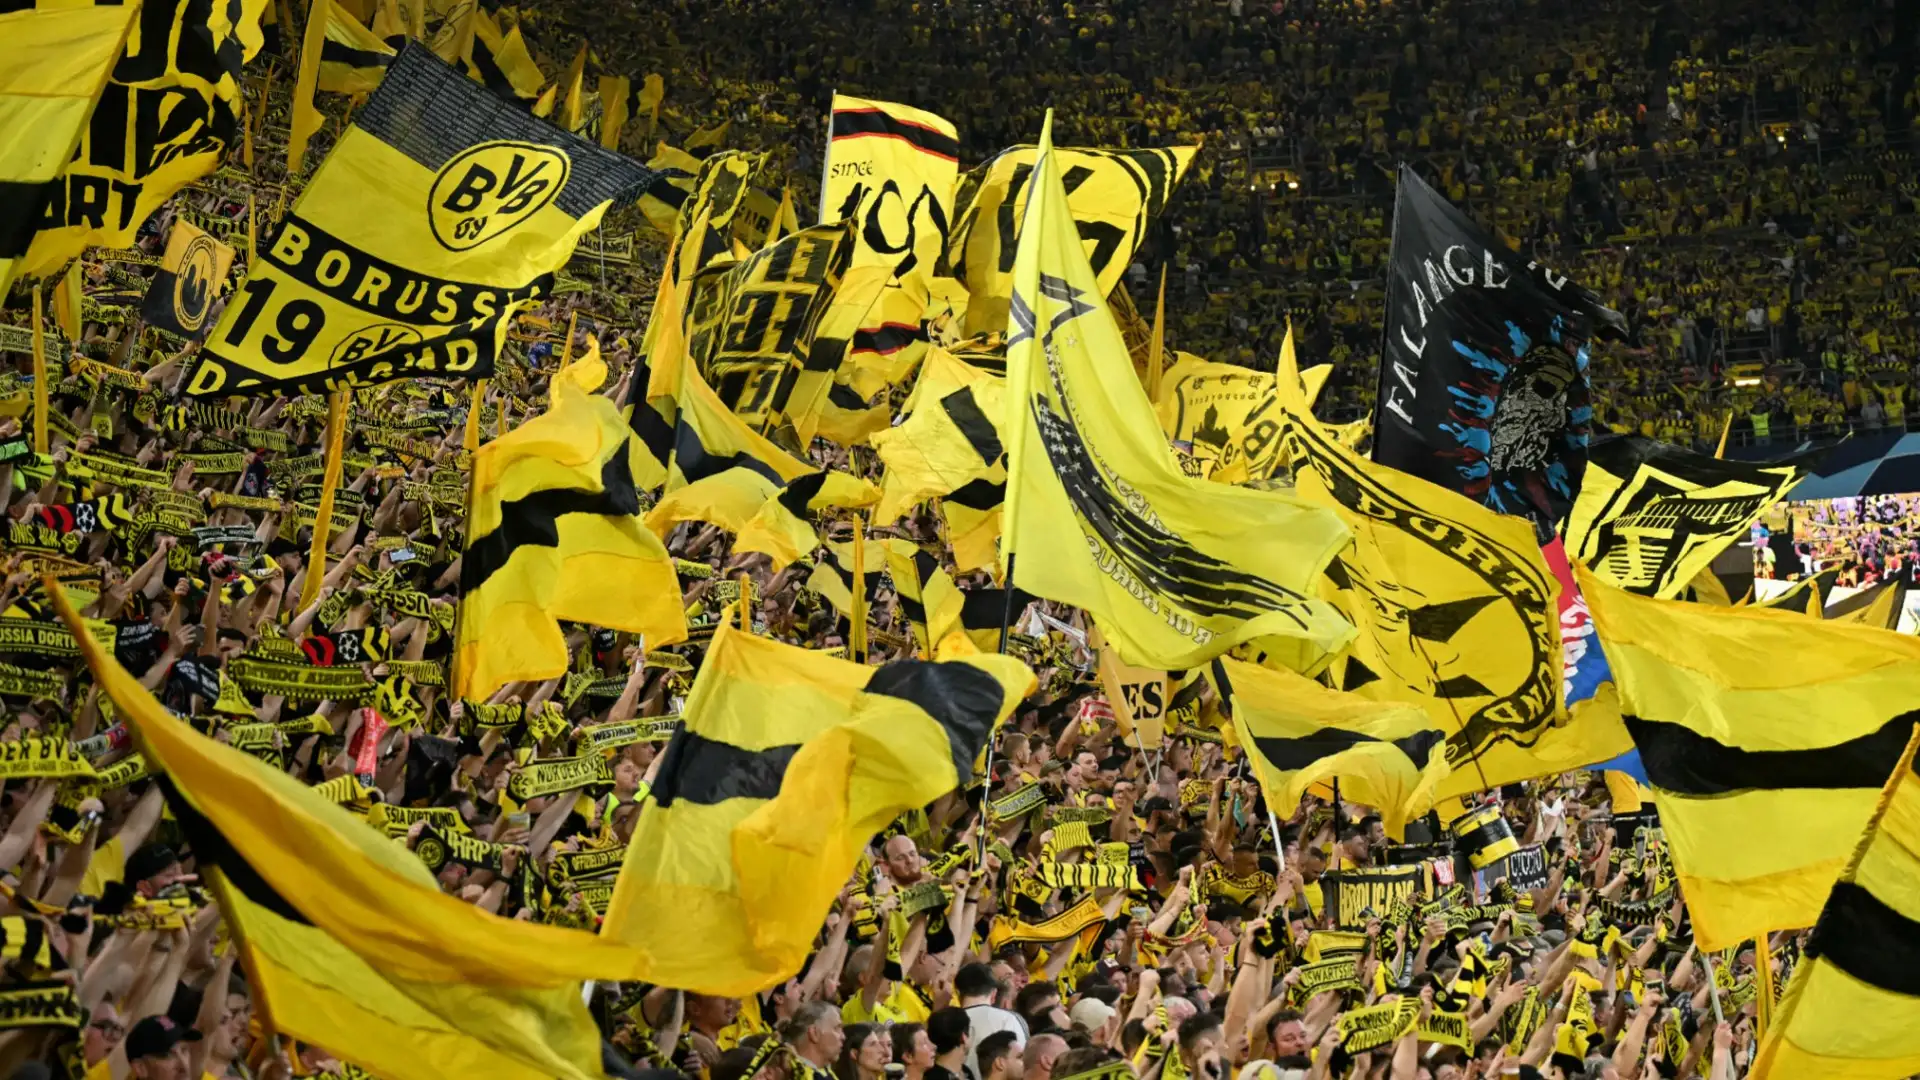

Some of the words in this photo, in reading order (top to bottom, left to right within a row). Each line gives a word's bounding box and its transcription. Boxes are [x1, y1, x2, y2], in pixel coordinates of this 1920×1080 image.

[442, 154, 552, 214] BVB
[270, 221, 541, 329] BORUSS
[224, 277, 326, 365] 19
[338, 327, 407, 363] BV
